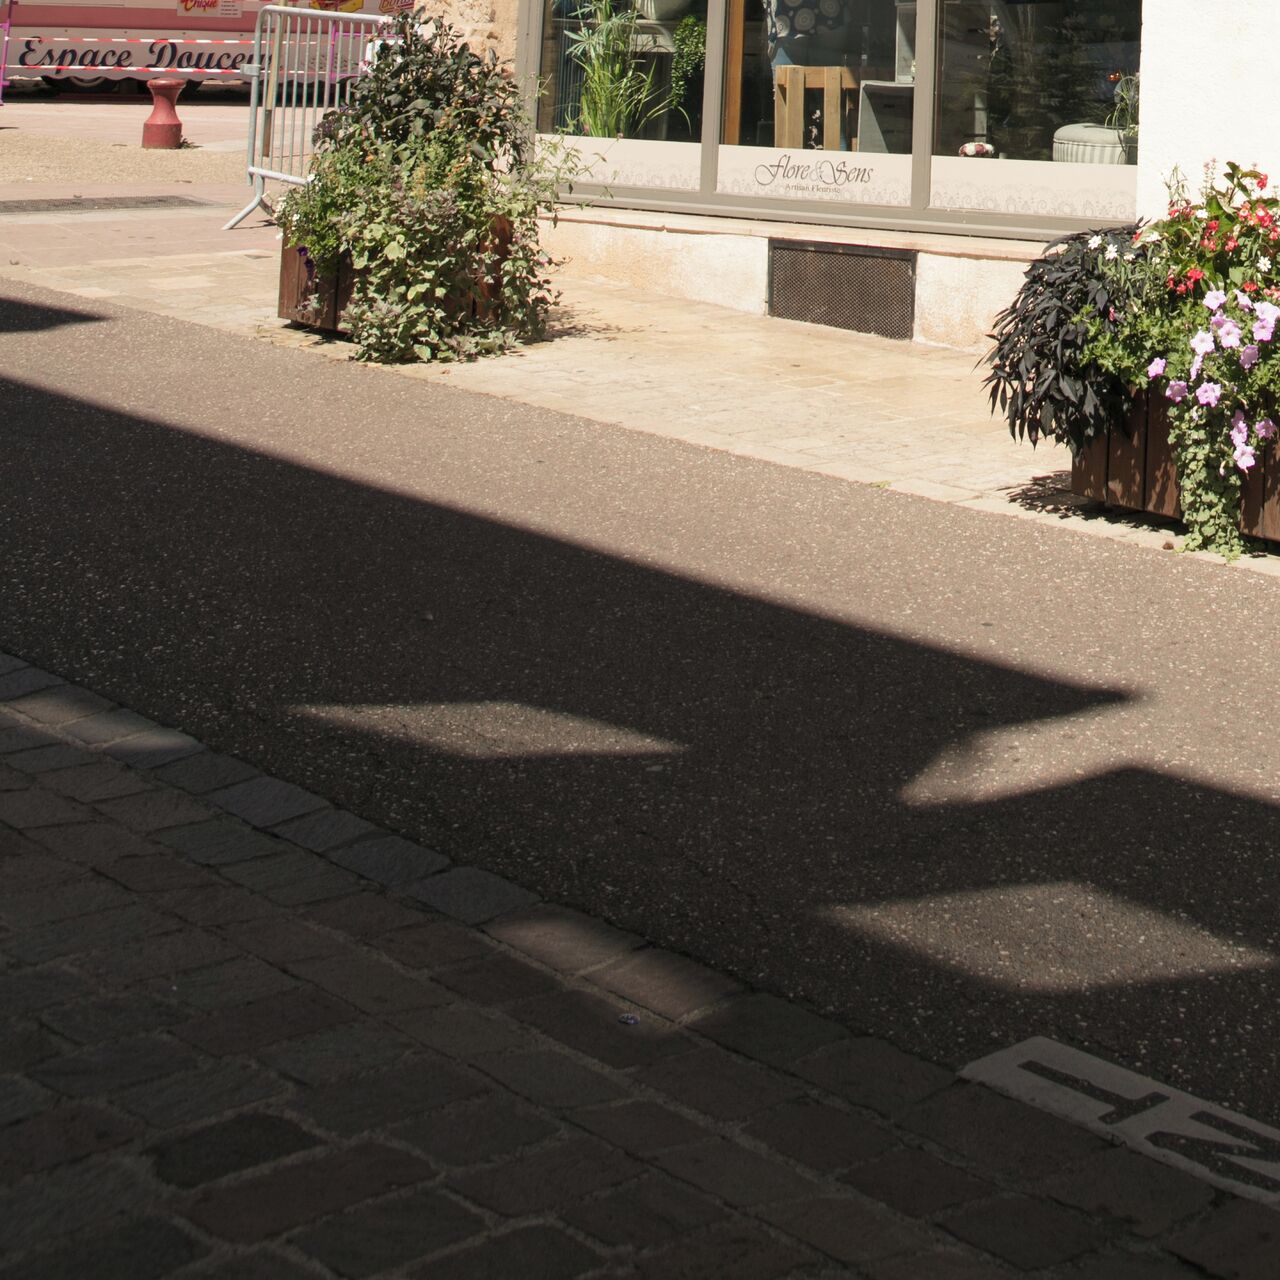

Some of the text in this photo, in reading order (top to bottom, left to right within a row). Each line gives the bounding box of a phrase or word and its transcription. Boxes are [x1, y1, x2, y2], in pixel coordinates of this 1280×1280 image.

[18, 36, 282, 74] Espace Douceu
[785, 183, 810, 192] Artisan
